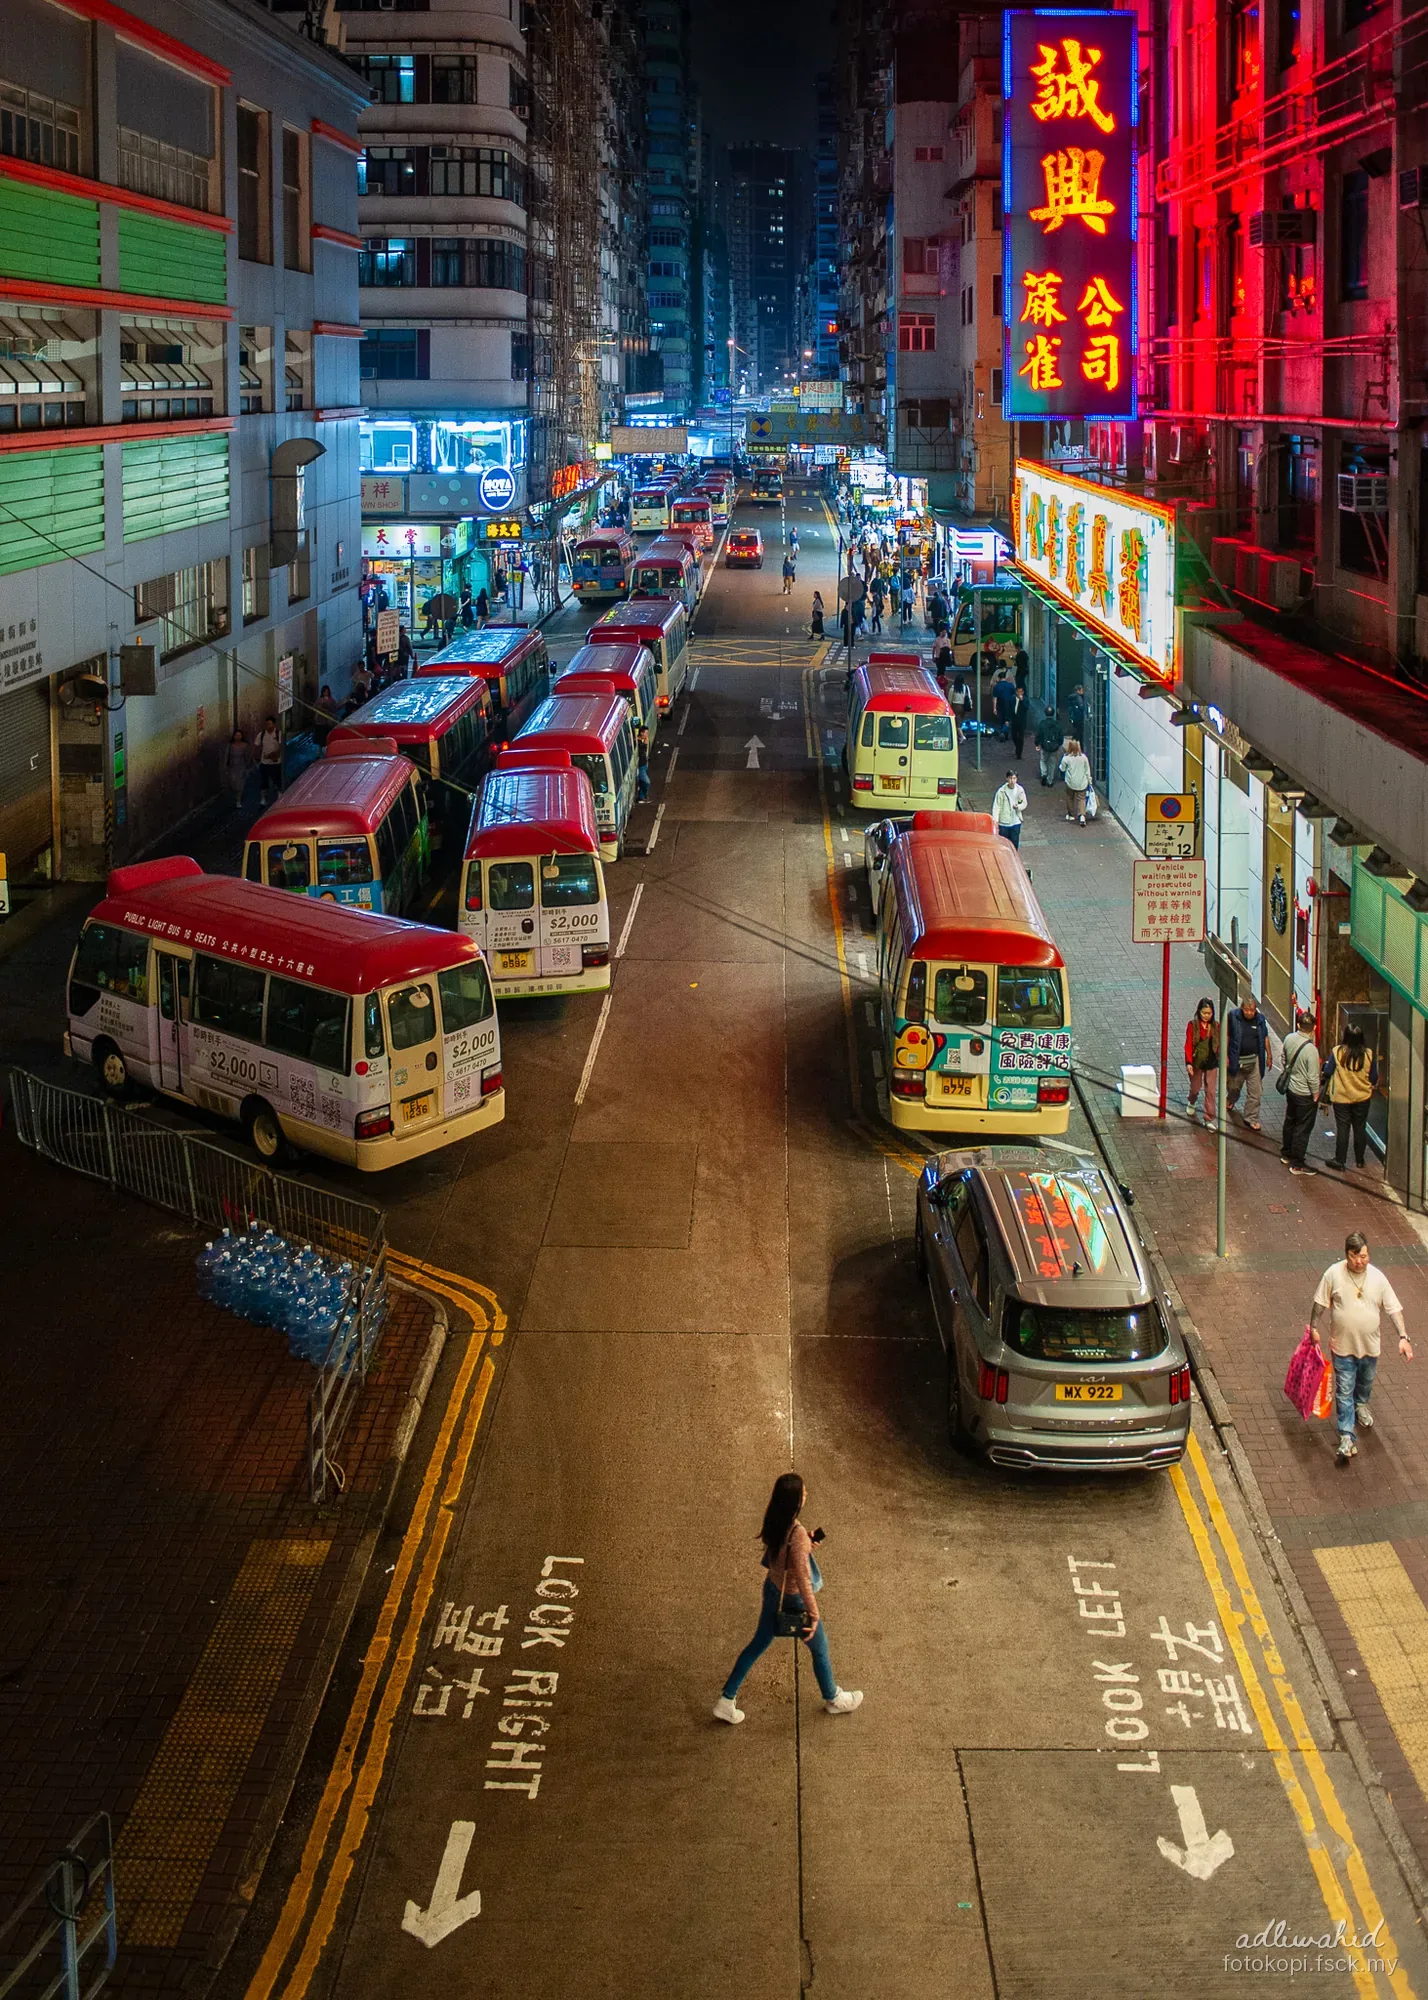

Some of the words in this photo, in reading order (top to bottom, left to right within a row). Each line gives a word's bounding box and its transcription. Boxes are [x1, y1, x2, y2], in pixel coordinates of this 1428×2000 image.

[1030, 38, 1116, 234] 誠興
[1077, 277, 1124, 391] 公司
[378, 501, 398, 509] SHOP
[376, 528, 418, 545] 天堂
[1177, 825, 1185, 836] 7
[1177, 844, 1192, 855] 12
[1142, 873, 1171, 881] waiting
[1147, 900, 1192, 910] 停車等候
[550, 914, 598, 929] $2,000
[1147, 914, 1192, 924] 會被檢控
[123, 911, 146, 926] PUBLIC
[148, 918, 167, 932] LIGHT
[167, 924, 181, 937] BUS
[184, 929, 191, 939] 16
[194, 932, 217, 947] SEATS
[1141, 928, 1196, 938] 而不予警告
[221, 940, 315, 976] 公共小型巴士十六座位
[452, 1030, 494, 1059] $2,000
[1000, 1031, 1071, 1050] 免費健康
[210, 1051, 257, 1082] $2,000
[999, 1052, 1070, 1071] 風險評估
[943, 1085, 971, 1095] 8776
[406, 1105, 428, 1120] 1236
[1065, 1387, 1082, 1398] MX
[1088, 1387, 1113, 1398] 922
[521, 1555, 584, 1649] LOOK
[1068, 1555, 1126, 1637] LEFT
[1092, 1660, 1161, 1773] LOOK
[484, 1669, 559, 1800] RIGHT
